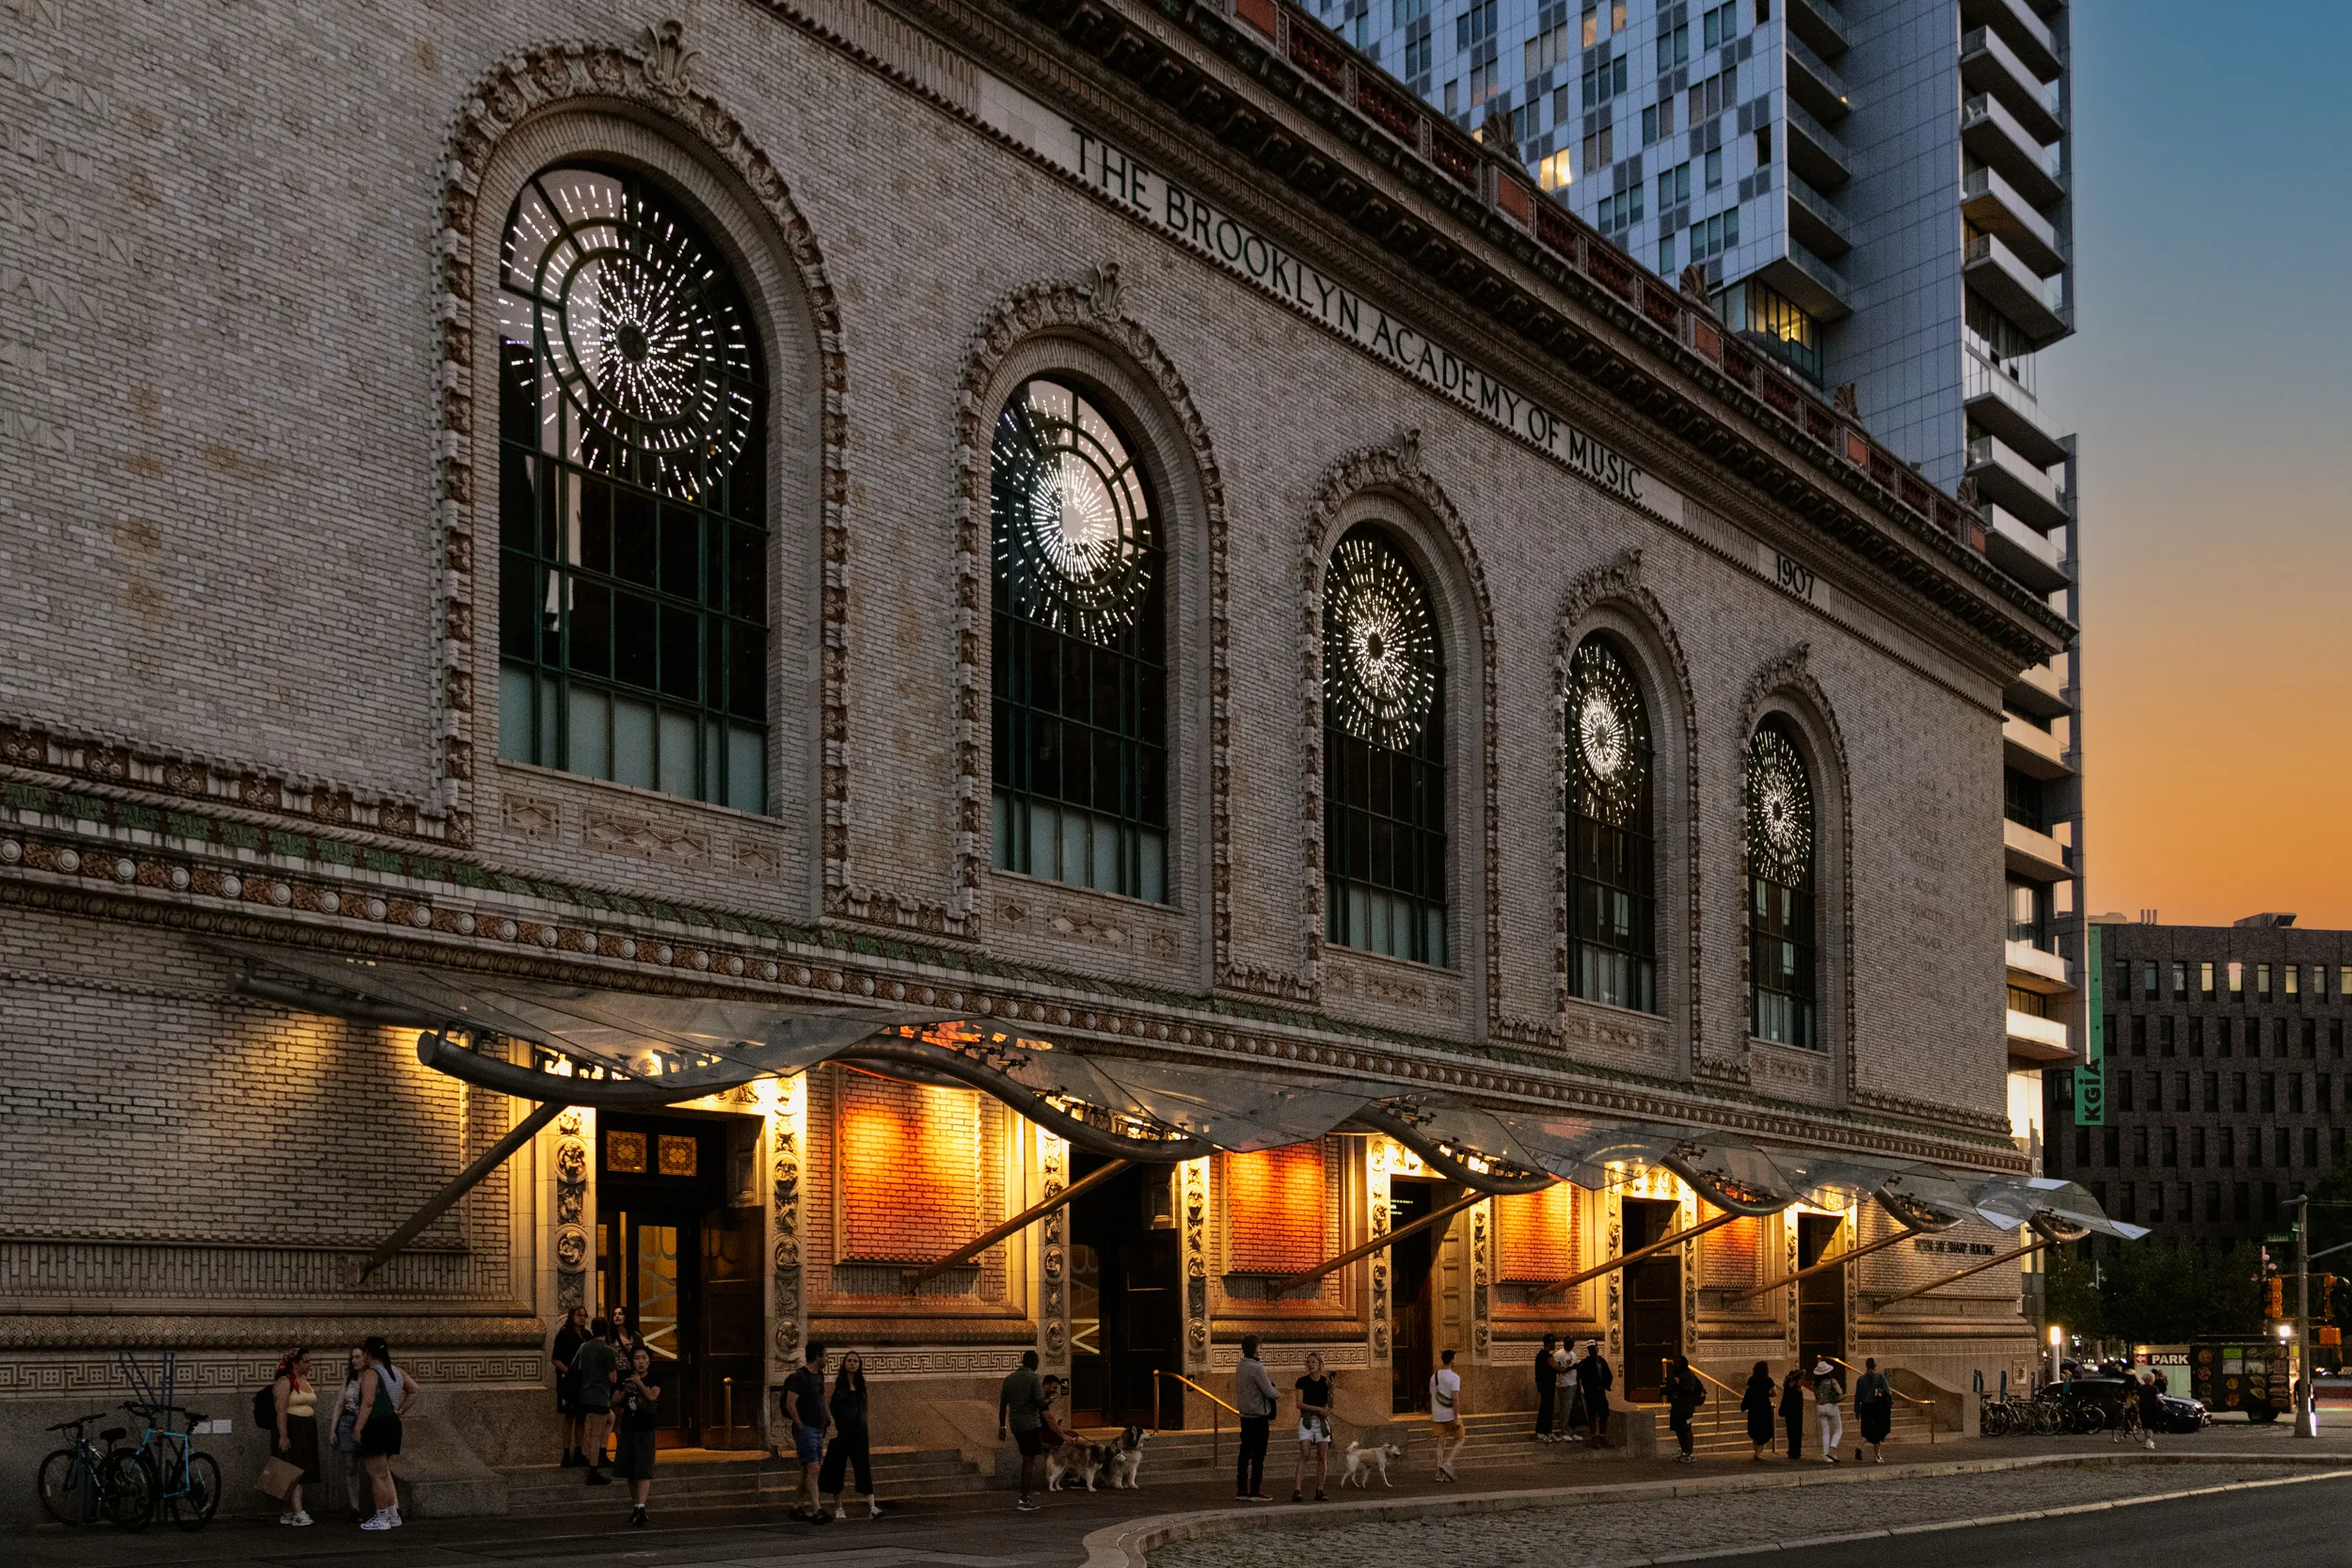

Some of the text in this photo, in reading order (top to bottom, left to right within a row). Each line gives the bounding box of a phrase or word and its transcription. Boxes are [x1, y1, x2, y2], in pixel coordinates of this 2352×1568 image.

[1071, 127, 1644, 499] THE BROOKLYN ACADEMY OF MUSIC
[1776, 554, 1815, 600] 1907
[2152, 1354, 2188, 1365] PARK
